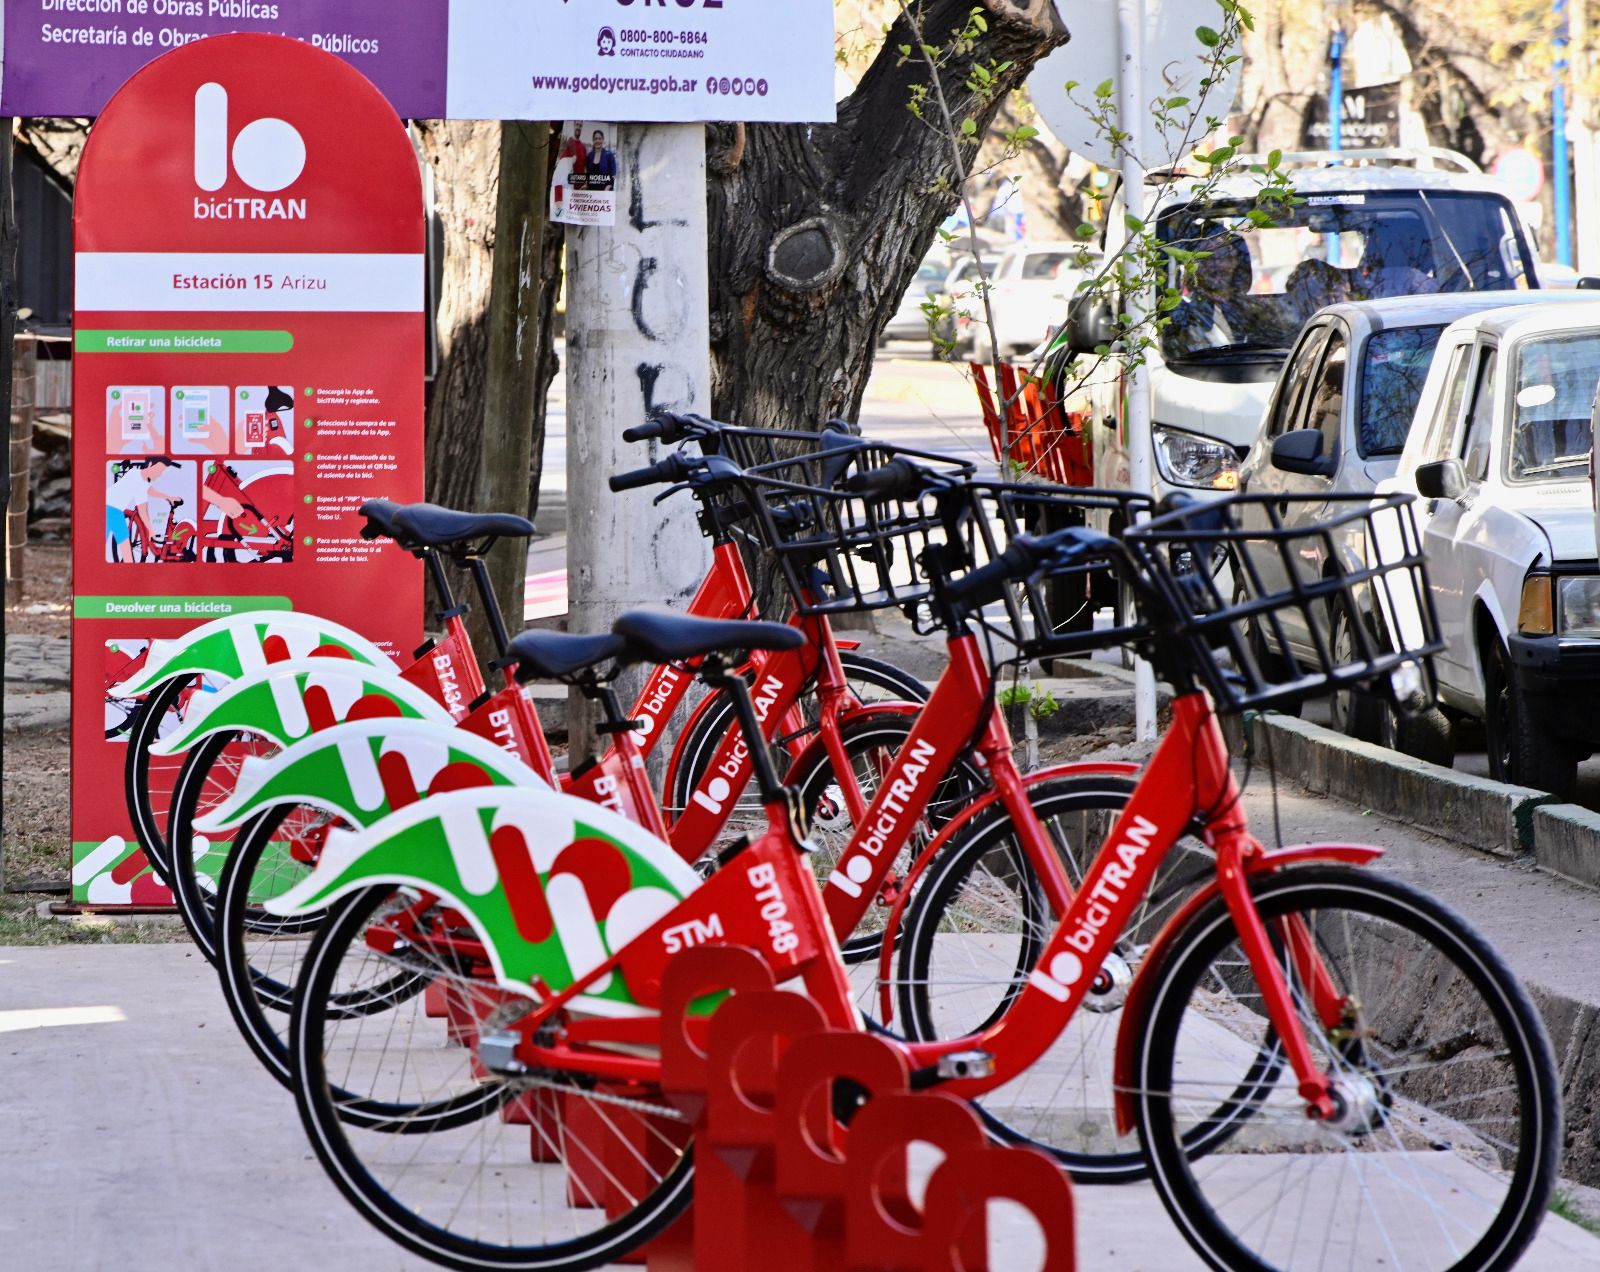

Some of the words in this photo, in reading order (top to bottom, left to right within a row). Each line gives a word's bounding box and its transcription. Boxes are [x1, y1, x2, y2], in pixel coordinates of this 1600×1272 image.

[126, 0, 149, 14] de
[153, 0, 204, 16] Obras
[208, 0, 279, 19] Públicas
[41, 24, 127, 45] Secretaría
[132, 26, 154, 46] de
[620, 29, 708, 44] 0800-800-6864
[620, 48, 659, 58] CONTACTO
[660, 49, 704, 59] CIUDADANO
[532, 74, 698, 94] www.godoycruz.gob.ar
[193, 197, 306, 220] biciTRAN
[569, 203, 612, 213] VIVIENDAS
[173, 273, 247, 289] Estación
[253, 274, 273, 289] 15
[280, 275, 327, 290] Arizu
[106, 336, 146, 347] Retirar
[149, 338, 171, 347] una
[174, 336, 222, 347] bicicleta
[373, 463, 383, 471] QR
[105, 602, 156, 613] Devolver
[160, 604, 181, 613] una
[184, 602, 232, 613] bicicleta
[433, 654, 466, 715] BT434
[858, 738, 937, 857] biciTRAN
[1064, 814, 1159, 954] biciTRAN
[747, 862, 800, 954] BT048
[661, 912, 725, 954] STM
